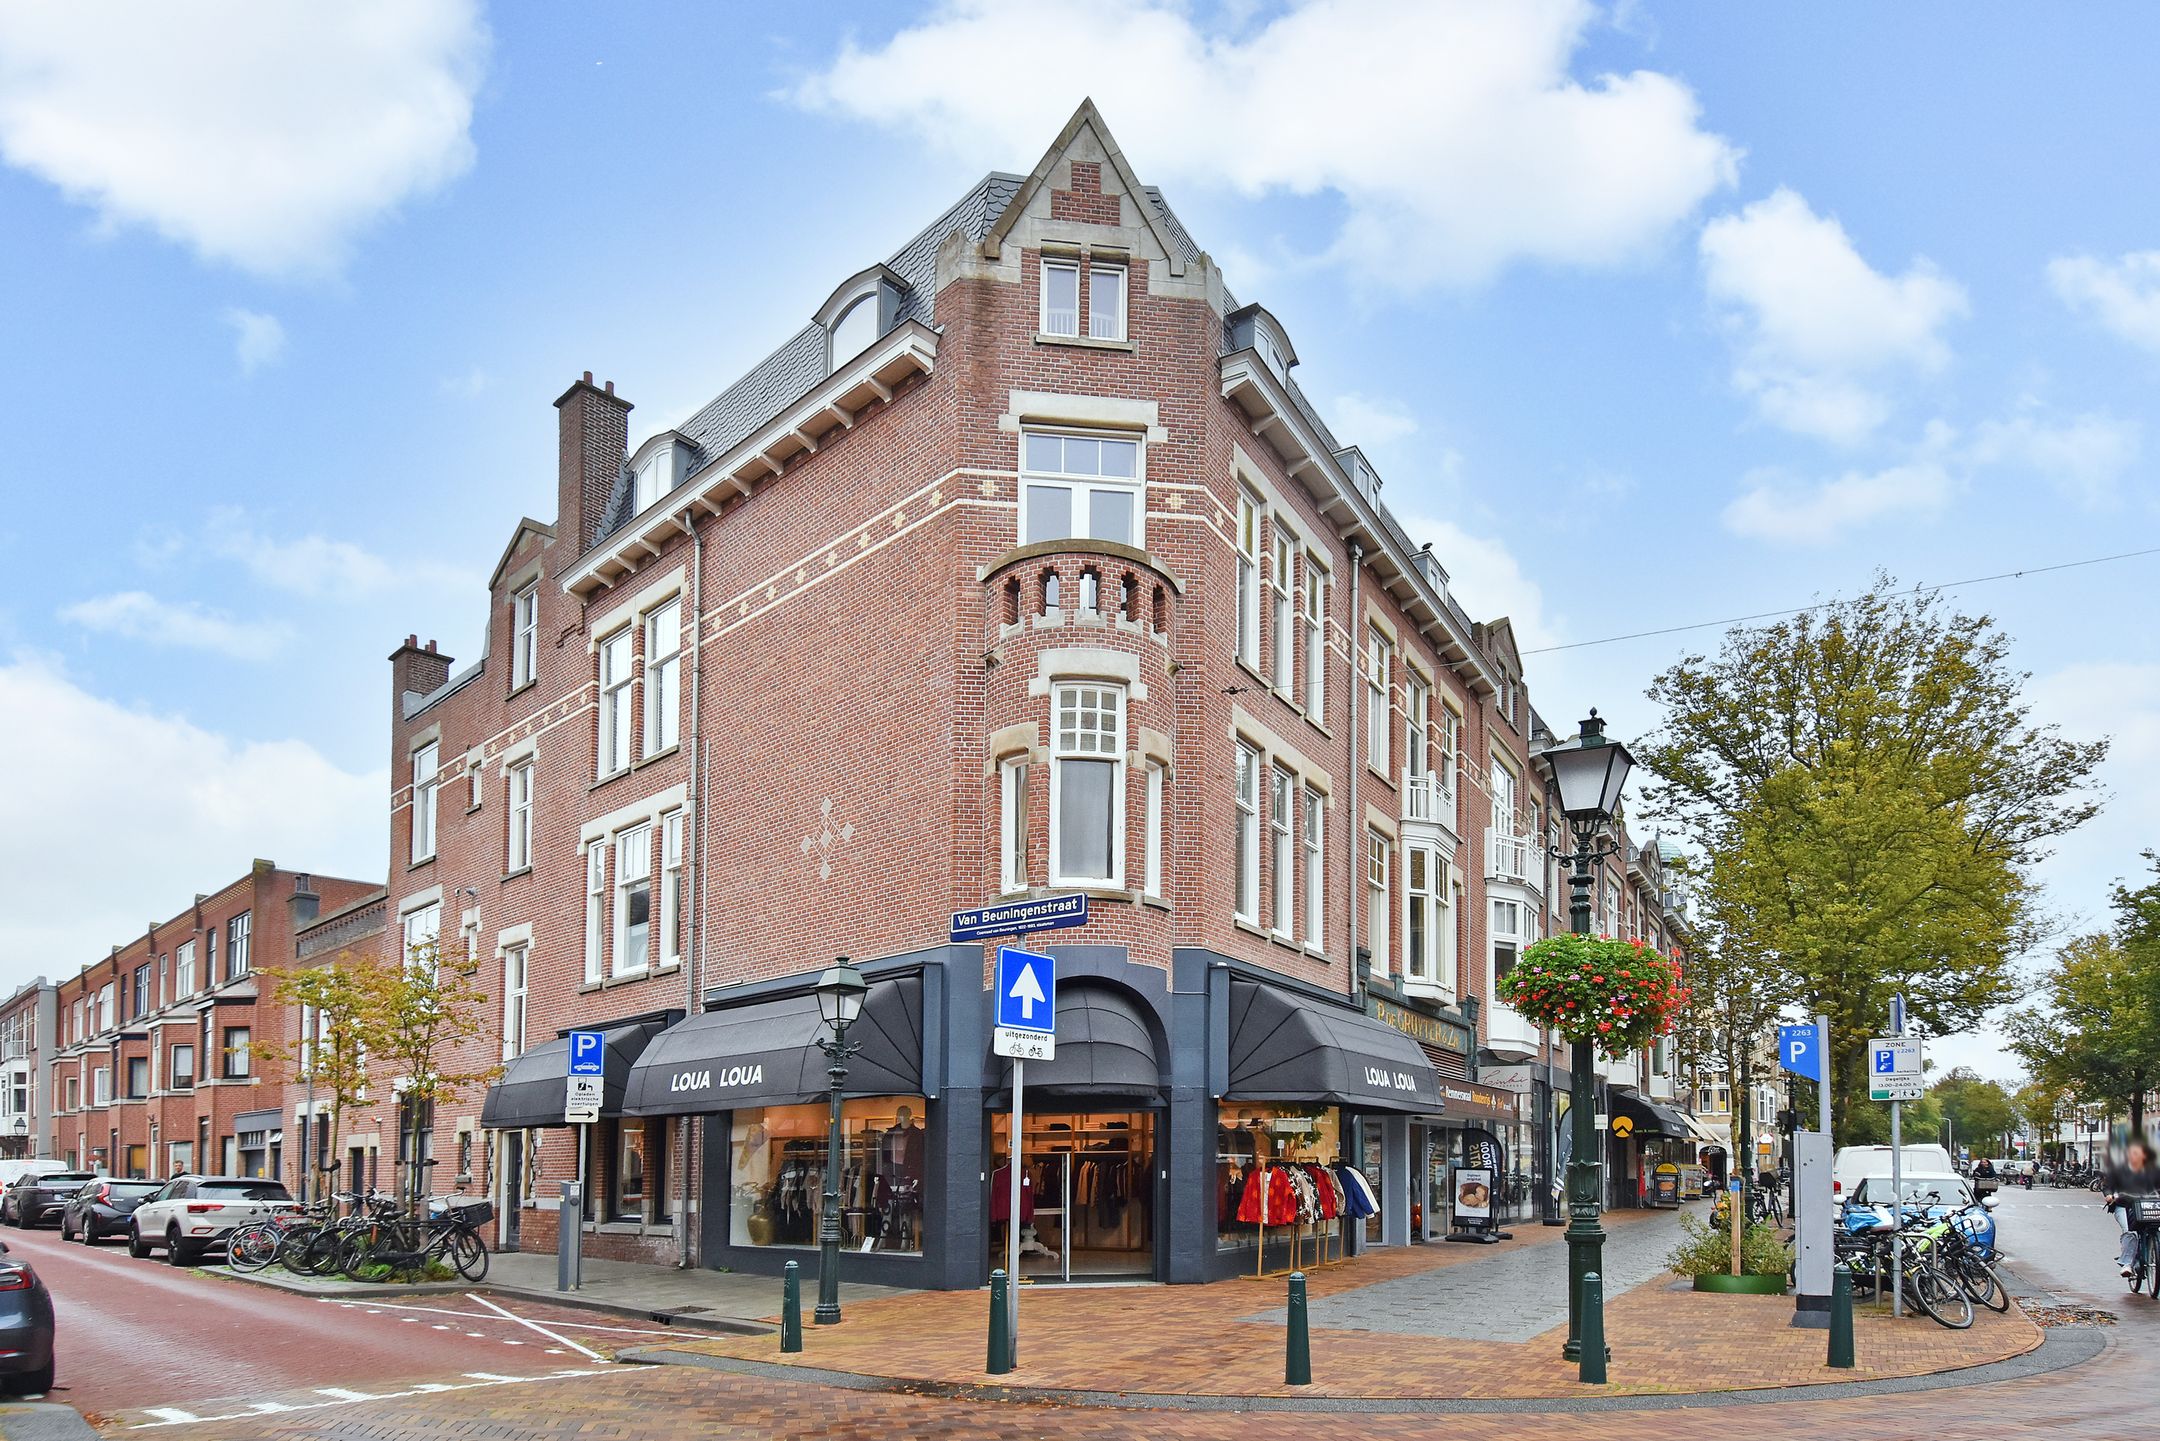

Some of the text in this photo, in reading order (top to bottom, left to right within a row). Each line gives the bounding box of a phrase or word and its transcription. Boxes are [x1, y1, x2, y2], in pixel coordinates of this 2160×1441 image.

[958, 898, 1077, 926] Van Beuningenstraat
[1005, 1030, 1048, 1041] uitgezonderd
[1792, 1029, 1811, 1037] 2263
[577, 1035, 596, 1057] P
[1790, 1041, 1806, 1063] P
[1880, 1051, 1890, 1062] P
[671, 1065, 763, 1092] LOUA LOUA
[1364, 1066, 1391, 1088] LOUA
[1392, 1071, 1417, 1092] LOUA
